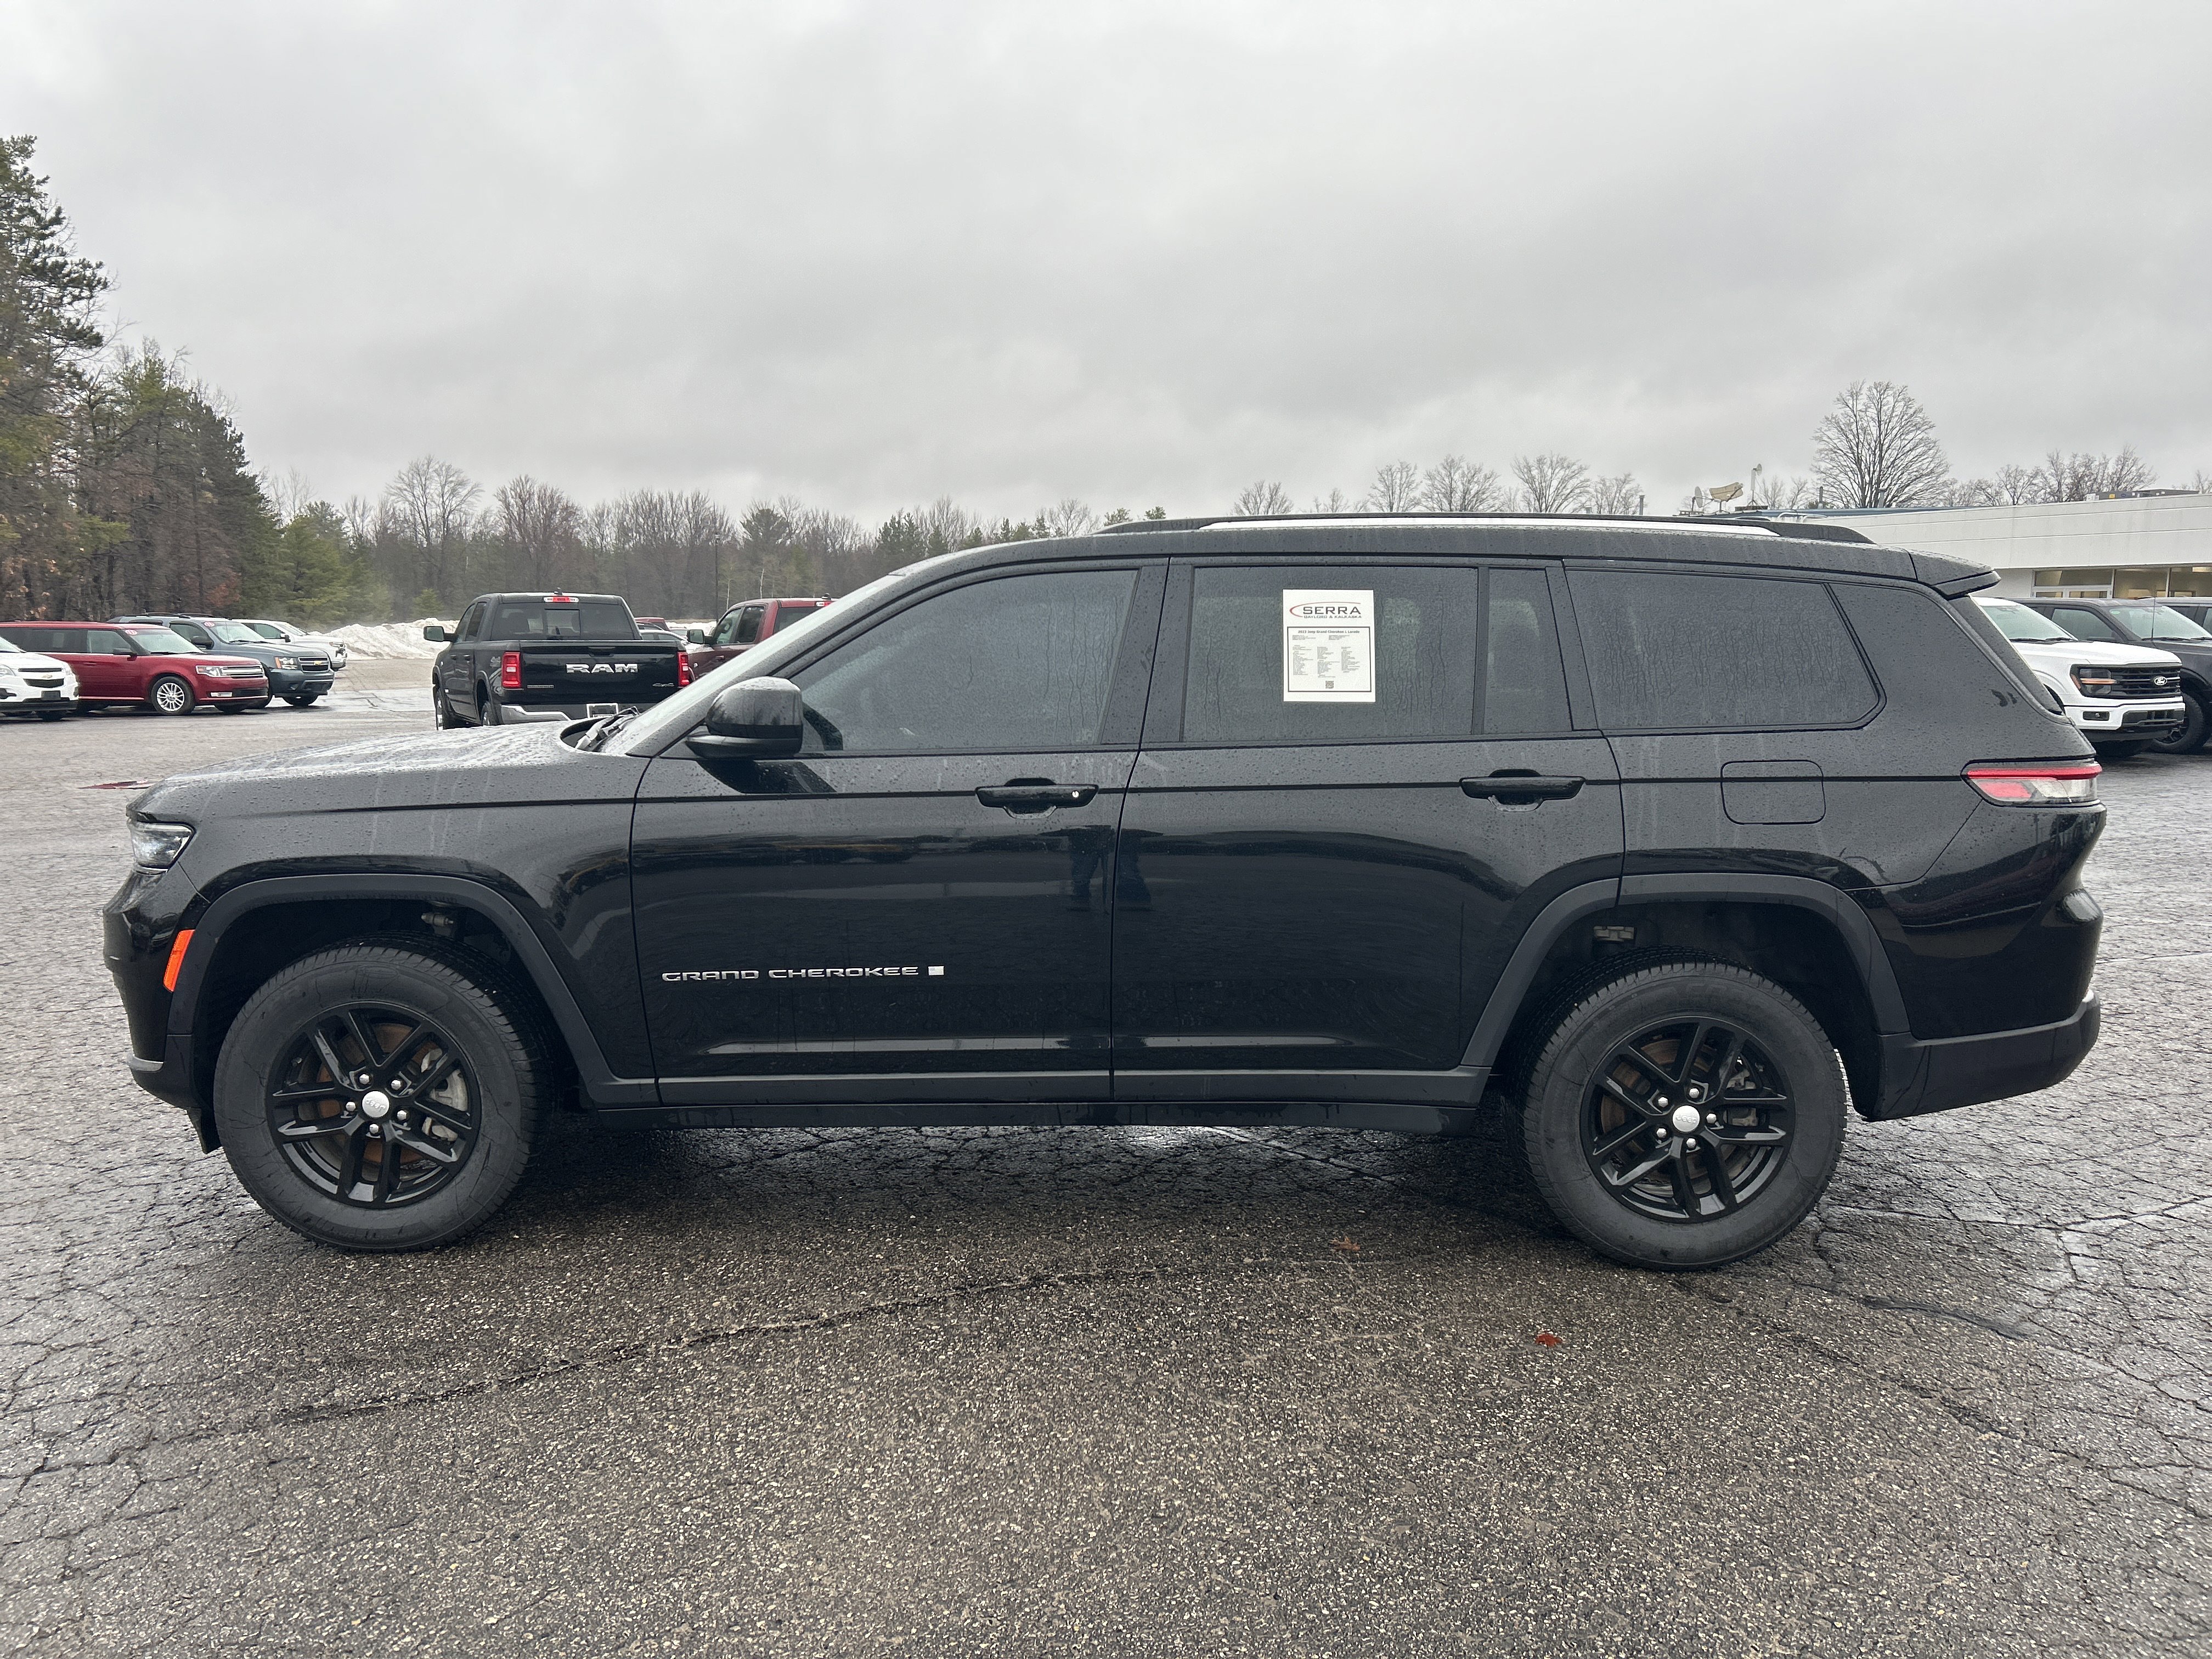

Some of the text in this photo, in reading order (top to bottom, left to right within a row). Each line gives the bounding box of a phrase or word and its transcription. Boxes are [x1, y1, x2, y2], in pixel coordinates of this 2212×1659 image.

[1303, 606, 1361, 614] SERRA
[566, 663, 638, 674] RAM
[662, 966, 919, 981] GRAND CHEROKEE
